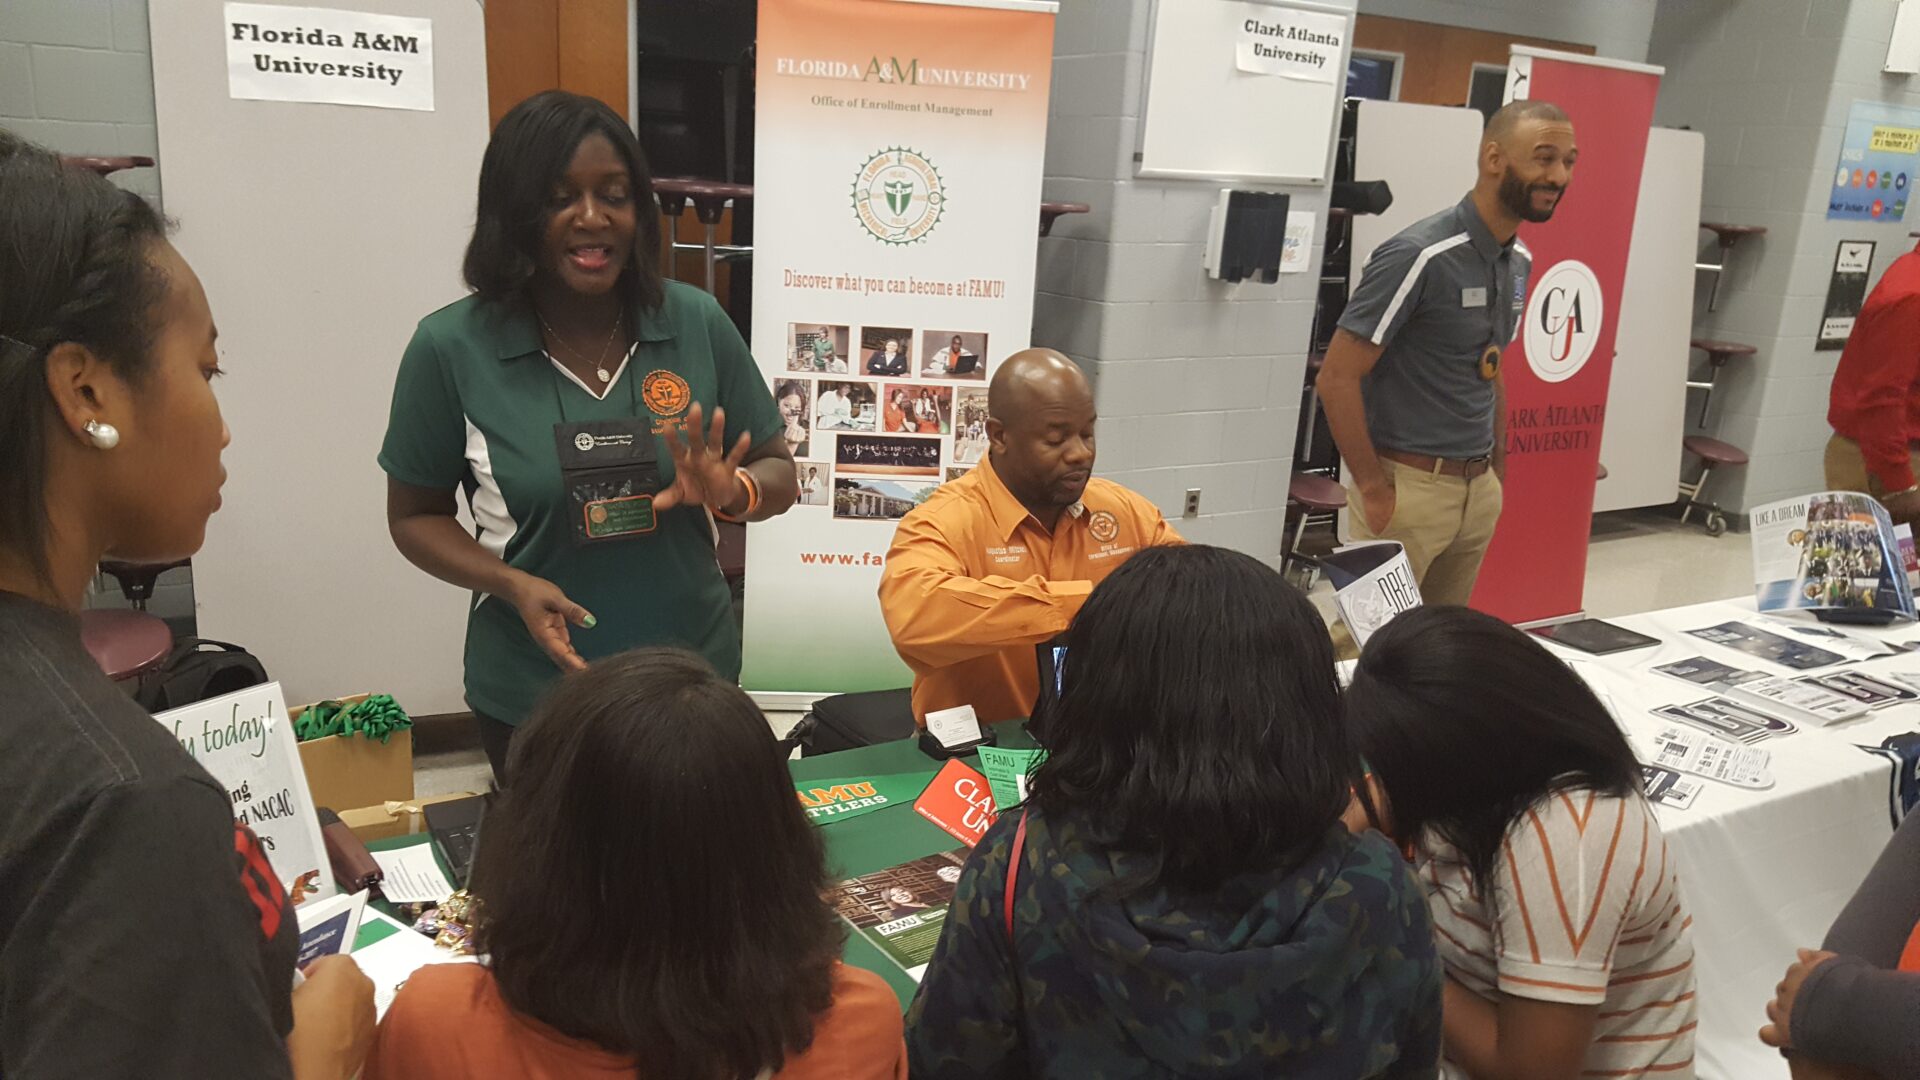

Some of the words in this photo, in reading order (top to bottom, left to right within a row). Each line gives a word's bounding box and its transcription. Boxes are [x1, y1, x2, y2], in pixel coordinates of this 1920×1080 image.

[231, 23, 344, 48] Florida
[352, 32, 419, 54] A&M
[1244, 19, 1285, 38] Clark
[1287, 26, 1340, 47] Atlanta
[253, 54, 403, 85] University
[1254, 42, 1326, 69] University
[776, 58, 861, 80] FLORIDA
[862, 55, 918, 86] A&M
[918, 67, 1031, 90] UNIVERSITY
[811, 95, 845, 108] Office
[847, 98, 857, 108] of
[860, 98, 921, 112] Enrollment
[924, 102, 993, 117] Management
[783, 268, 833, 290] Discover
[835, 272, 862, 291] what
[864, 278, 884, 297] you
[886, 279, 906, 294] can
[908, 276, 953, 297] become
[956, 281, 967, 297] at
[968, 279, 1005, 298] FAMU!
[1504, 429, 1593, 455] UNIVERSITY
[1755, 510, 1769, 526] LIKE
[1771, 509, 1778, 522] A
[1779, 503, 1806, 521] DREAM
[202, 700, 273, 758] today!
[984, 753, 1016, 768] FAMU
[251, 788, 295, 822] NACAC
[879, 916, 918, 934] FAMU
